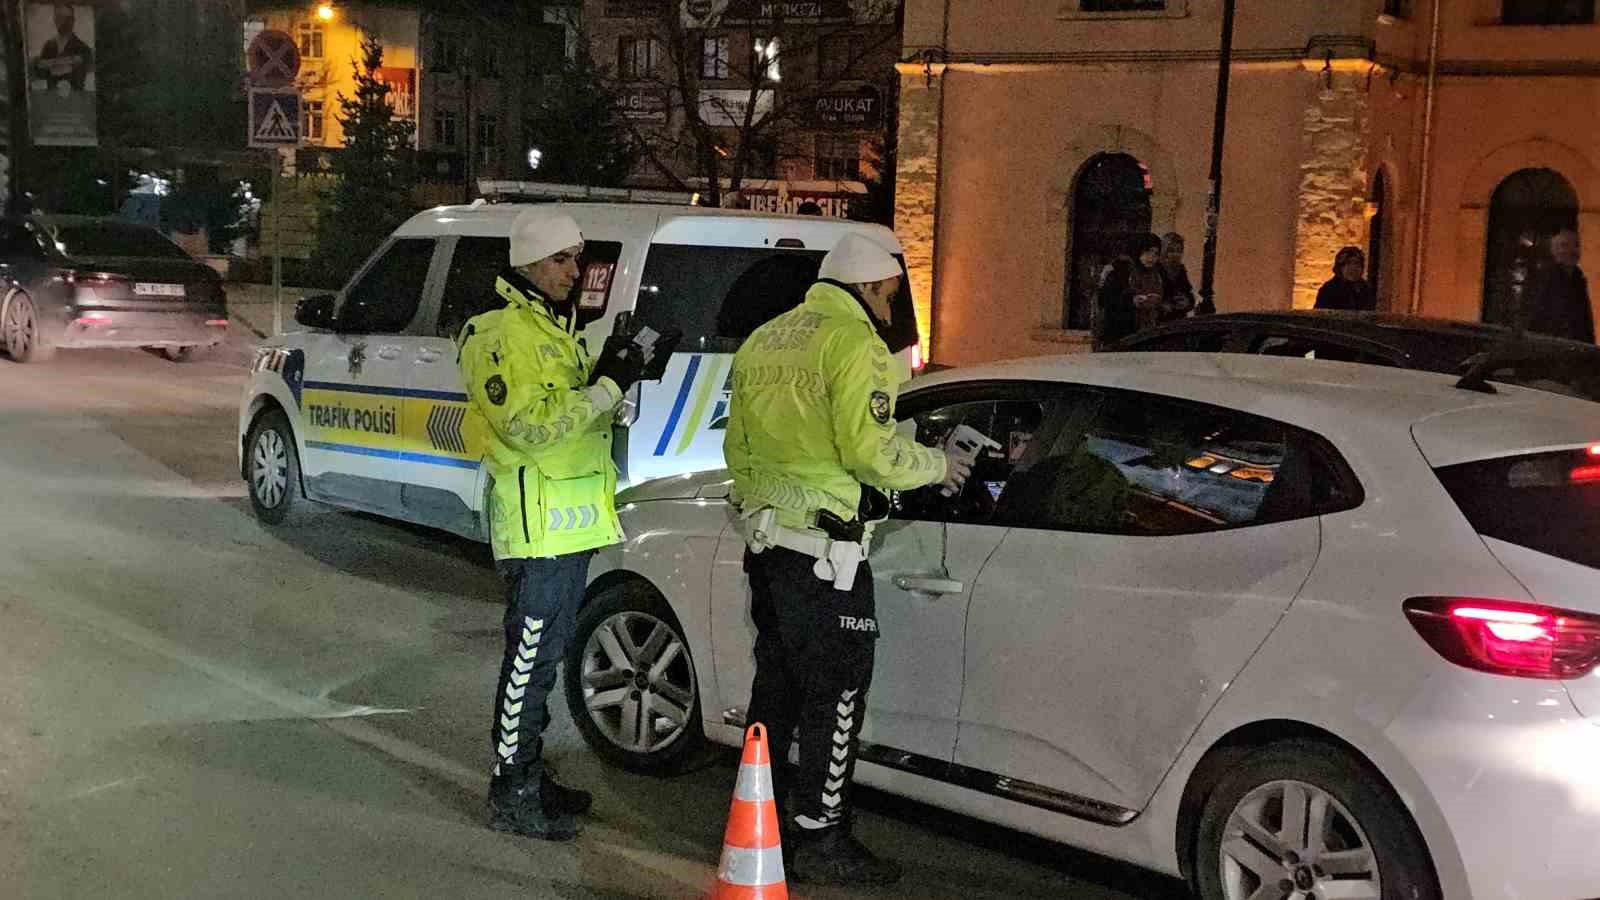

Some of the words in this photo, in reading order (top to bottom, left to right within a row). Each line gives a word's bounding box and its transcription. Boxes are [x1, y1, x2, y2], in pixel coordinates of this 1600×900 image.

[816, 97, 874, 112] AVUKAT
[308, 401, 351, 429] TRAFİK
[354, 407, 396, 435] POLİSİ
